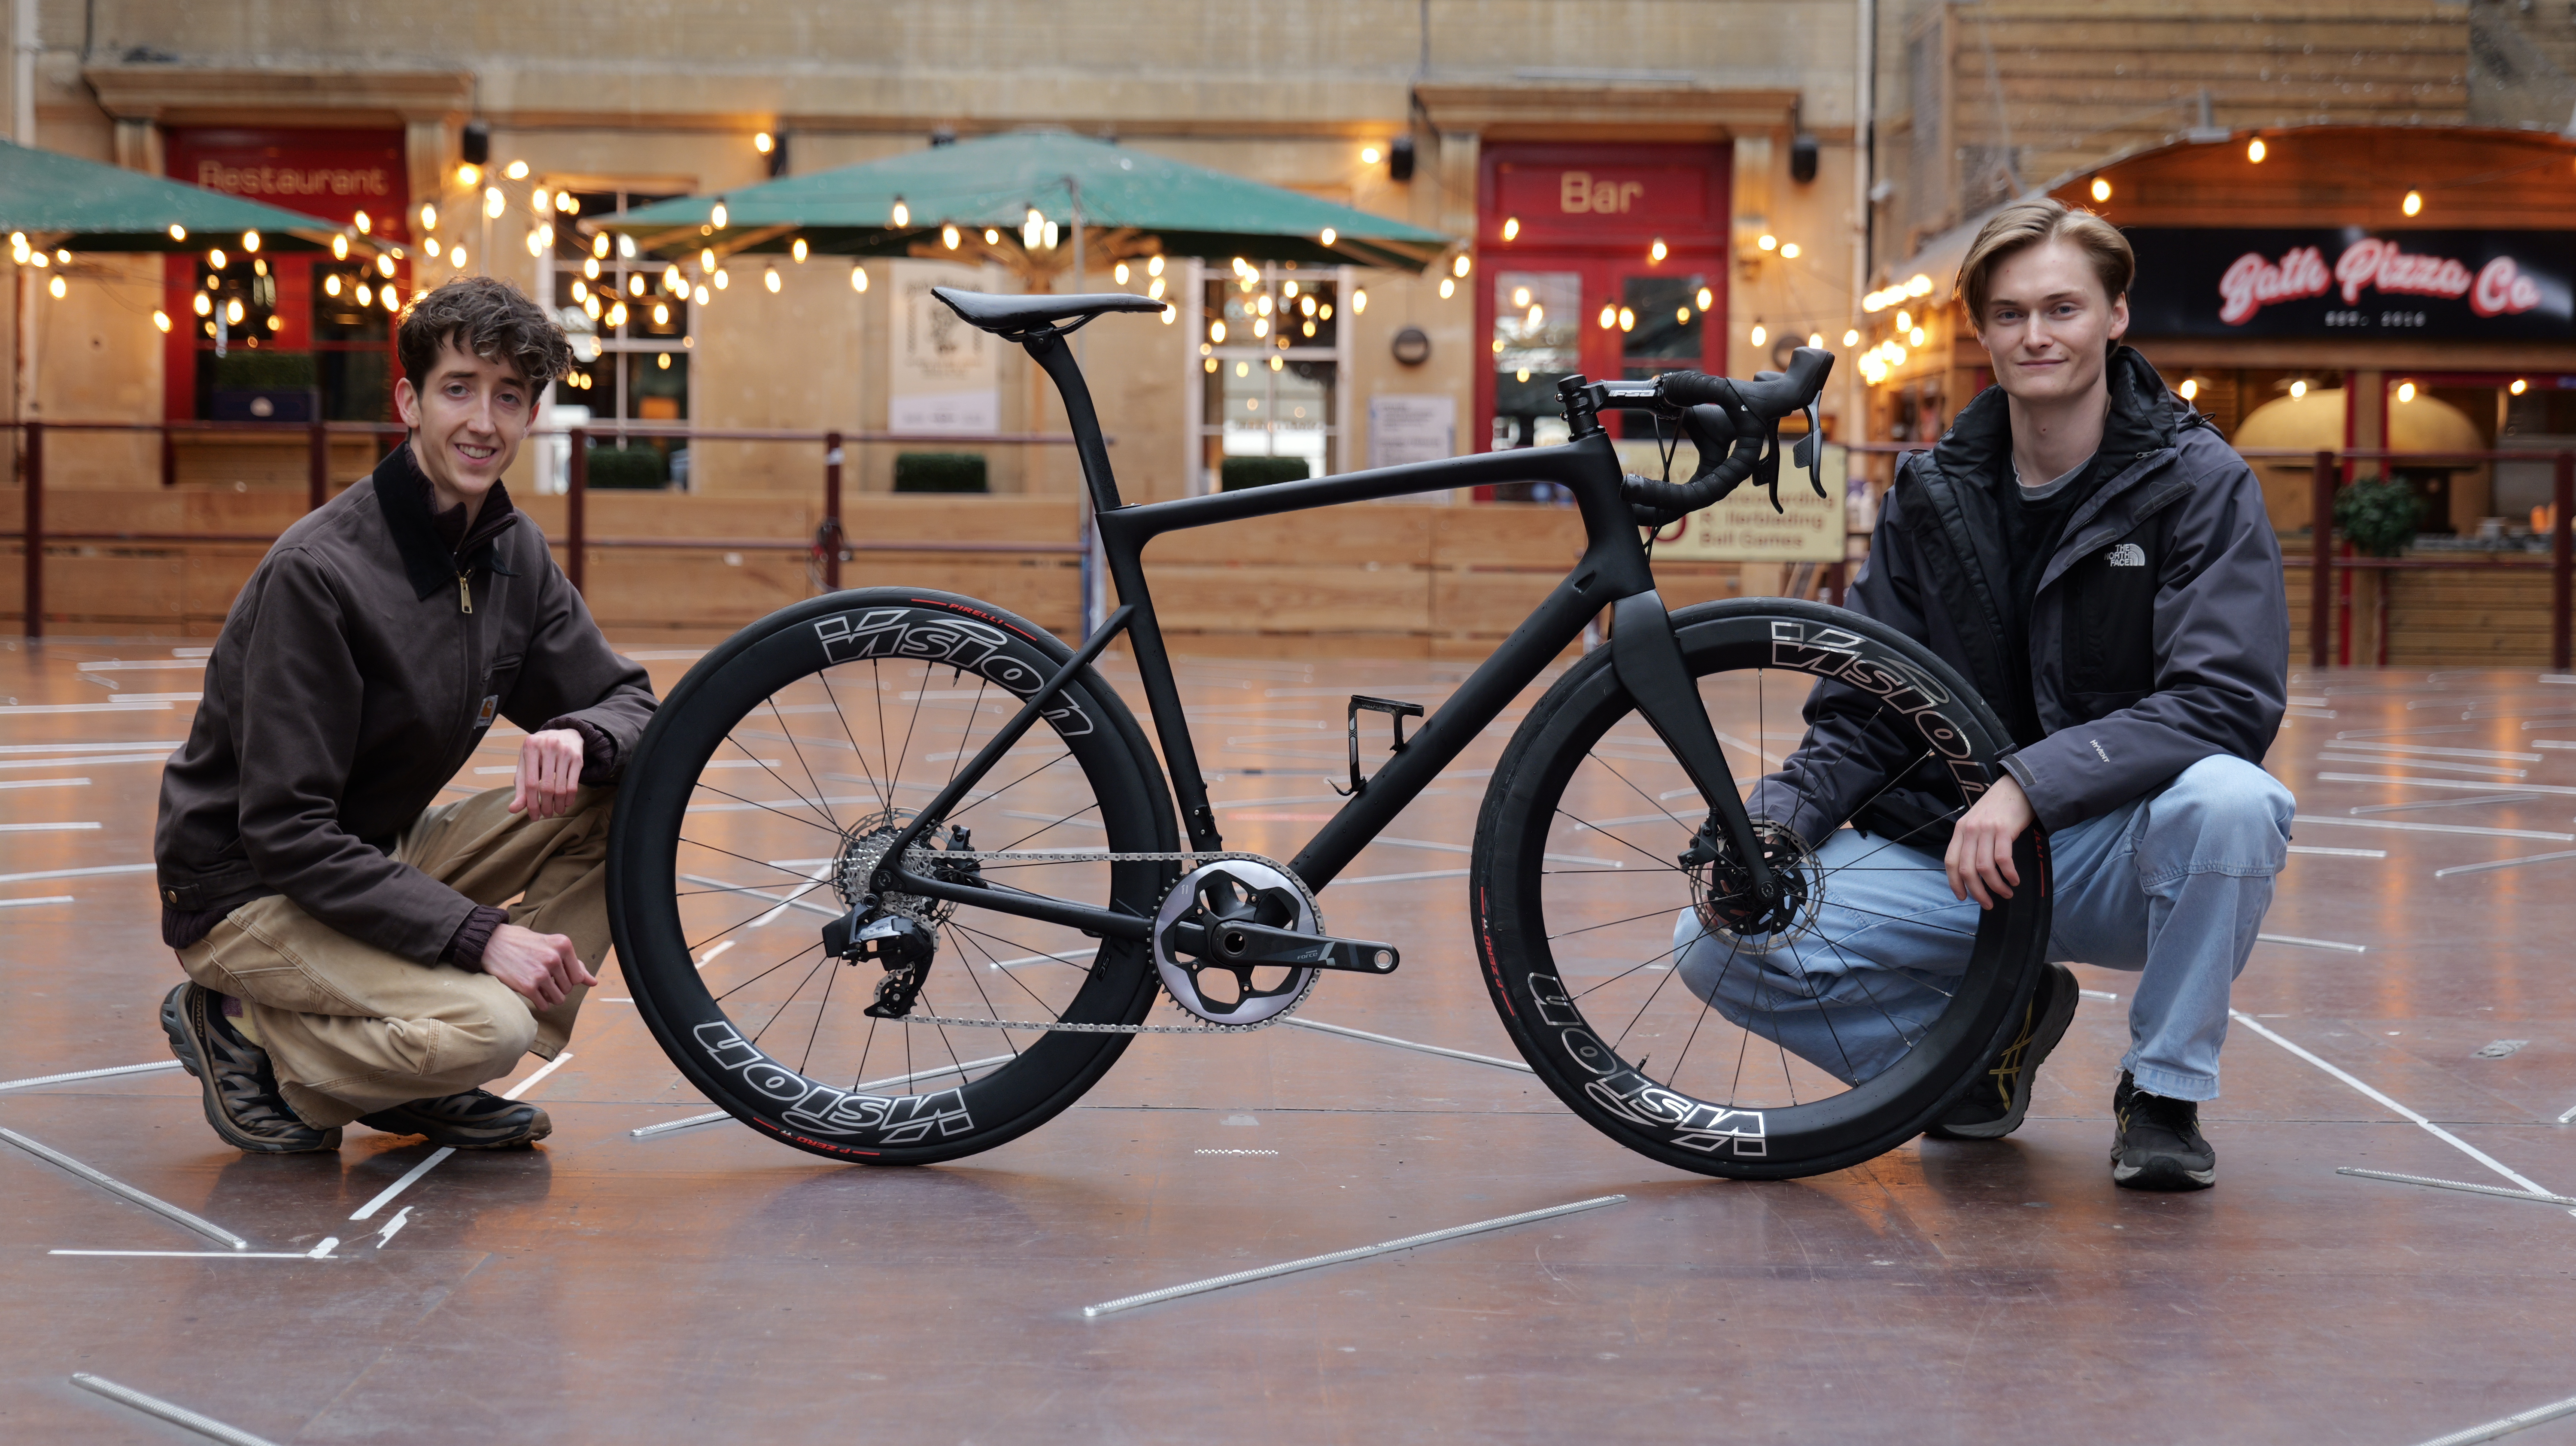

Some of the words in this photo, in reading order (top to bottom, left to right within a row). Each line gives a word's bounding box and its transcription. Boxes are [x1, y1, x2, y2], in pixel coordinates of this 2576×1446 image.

[198, 160, 389, 196] Restaurant
[1561, 171, 1644, 214] Bar
[2219, 246, 2332, 326] Bath
[2335, 237, 2474, 306] Pizza
[2470, 255, 2542, 318] Co
[1699, 529, 1735, 548] Ball
[1739, 530, 1805, 549] Games
[2115, 544, 2129, 552] THE
[2104, 551, 2129, 560] NORTH
[2110, 559, 2129, 567] FACE
[948, 603, 1003, 624] PIRELLI
[2090, 739, 2110, 762] HYVENT
[1484, 935, 1499, 976] ZERO
[1495, 978, 1504, 988] P
[796, 1136, 838, 1151] ZERO
